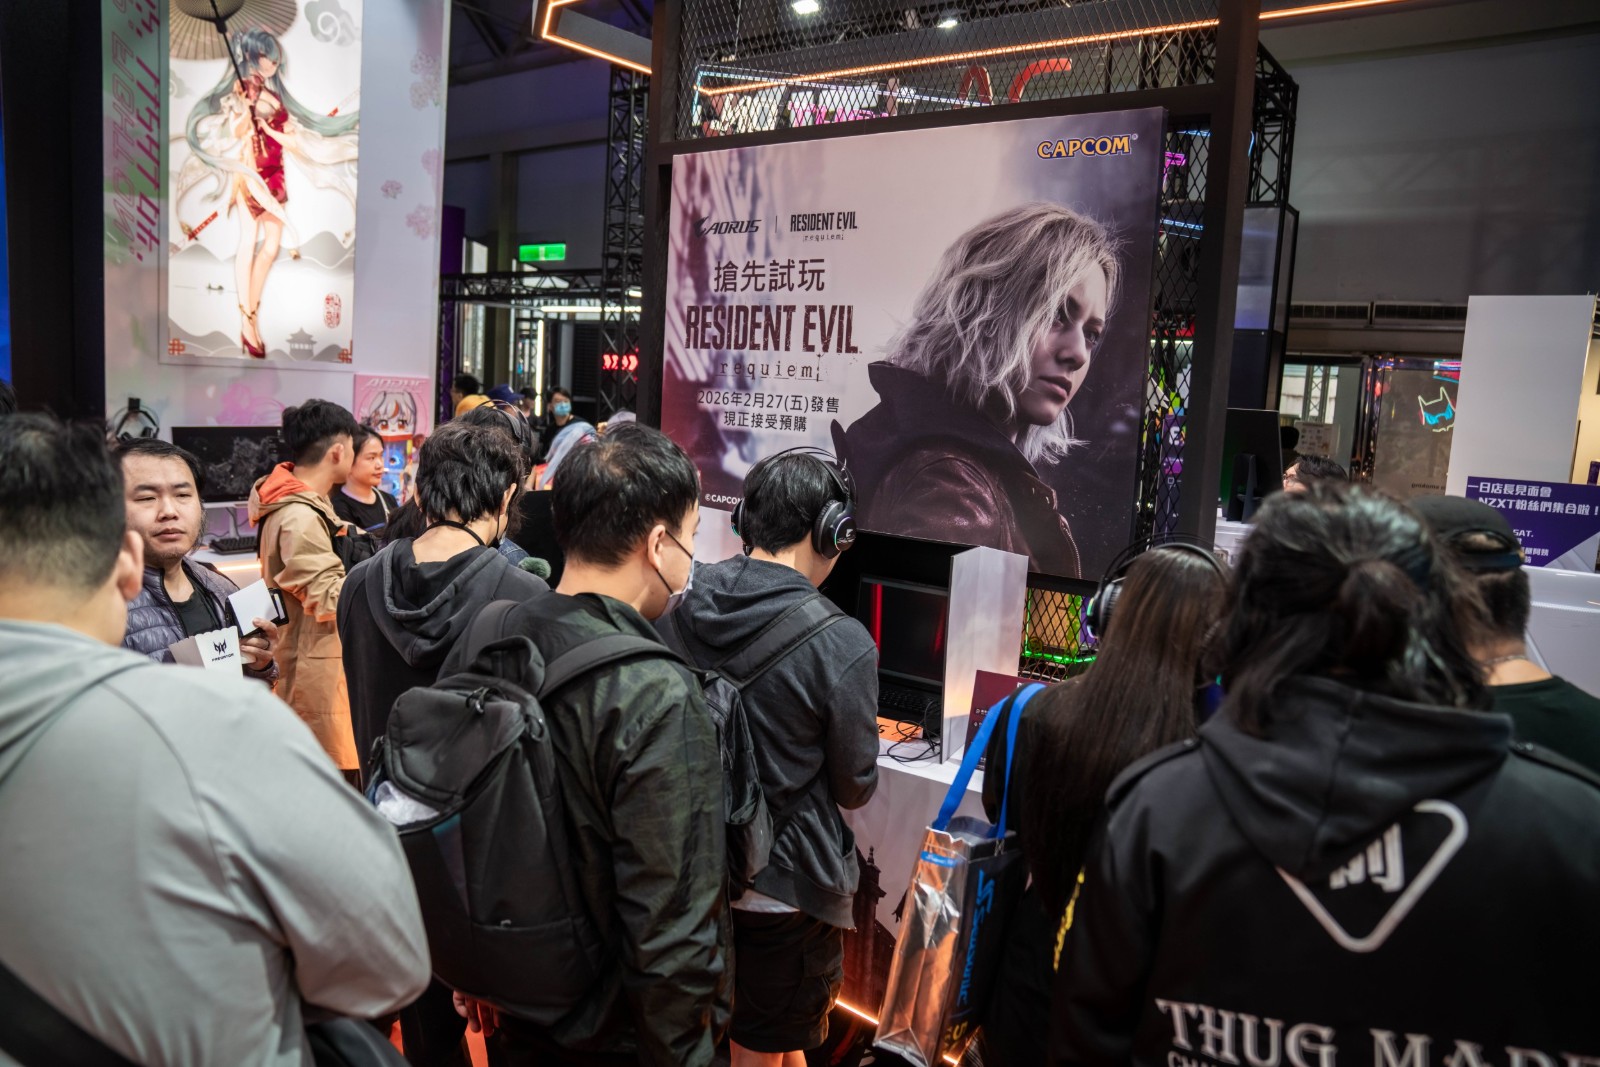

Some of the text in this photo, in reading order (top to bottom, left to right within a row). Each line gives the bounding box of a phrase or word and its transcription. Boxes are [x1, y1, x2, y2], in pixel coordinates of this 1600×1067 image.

[704, 219, 762, 235] AORUS
[790, 211, 858, 232] RESIDENT EVIL
[714, 258, 826, 292] 搶先試玩
[685, 304, 859, 354] RESIDENT EVIL
[697, 390, 840, 414] 2026年2月27(五)發售
[724, 411, 808, 432] 現正接受預購
[1467, 481, 1552, 498] 一日店長見面會
[1155, 998, 1600, 1067] THUG MA
